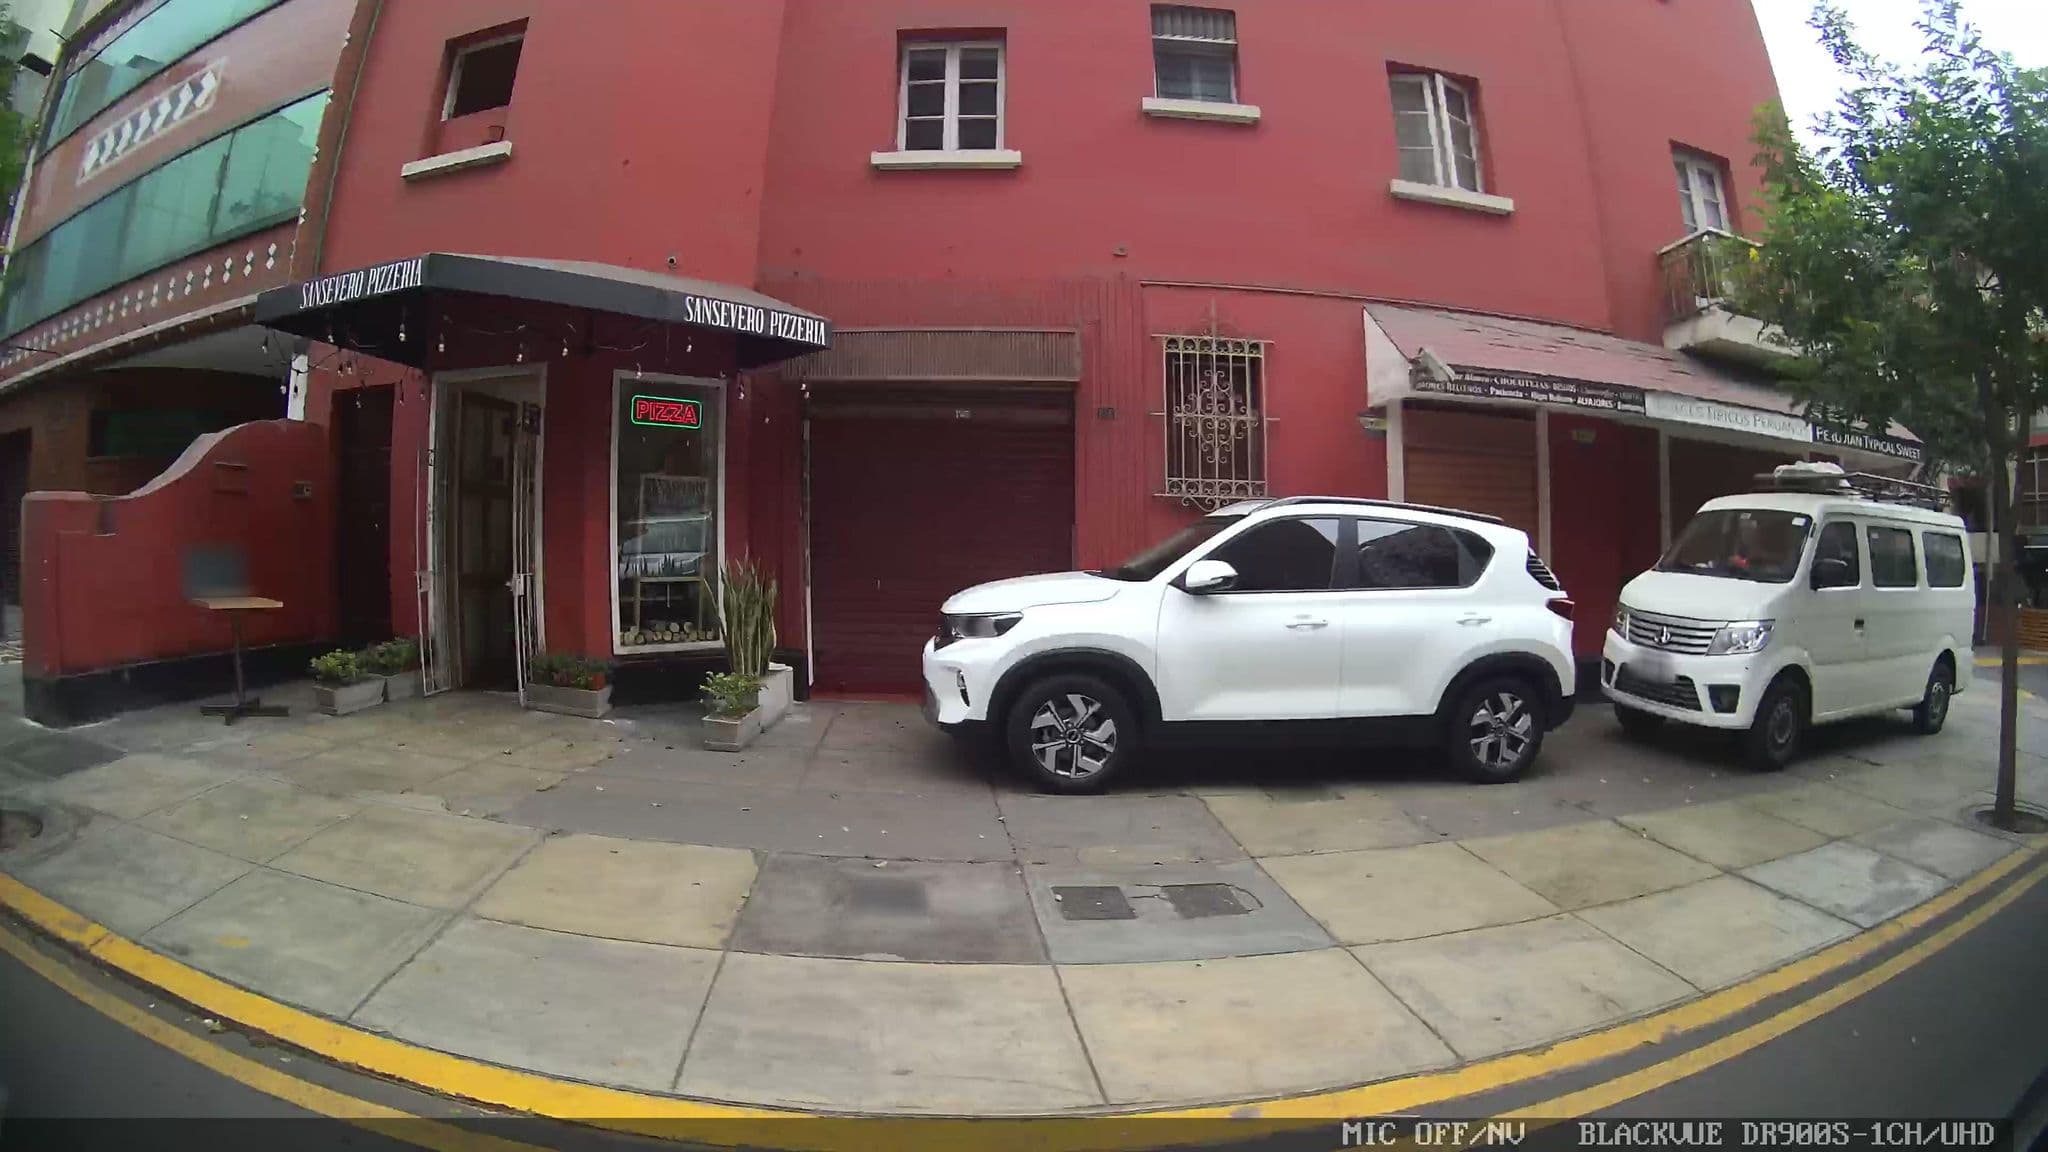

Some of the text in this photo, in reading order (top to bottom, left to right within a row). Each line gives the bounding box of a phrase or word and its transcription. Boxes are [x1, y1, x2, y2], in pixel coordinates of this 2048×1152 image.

[299, 258, 423, 309] SANSEVERO PIZZERIA
[684, 296, 826, 346] SANSEVERO PIZZERIA
[636, 399, 697, 424] PIZZA
[1863, 435, 1895, 454] TYPICAL
[1895, 443, 1921, 459] SWEET
